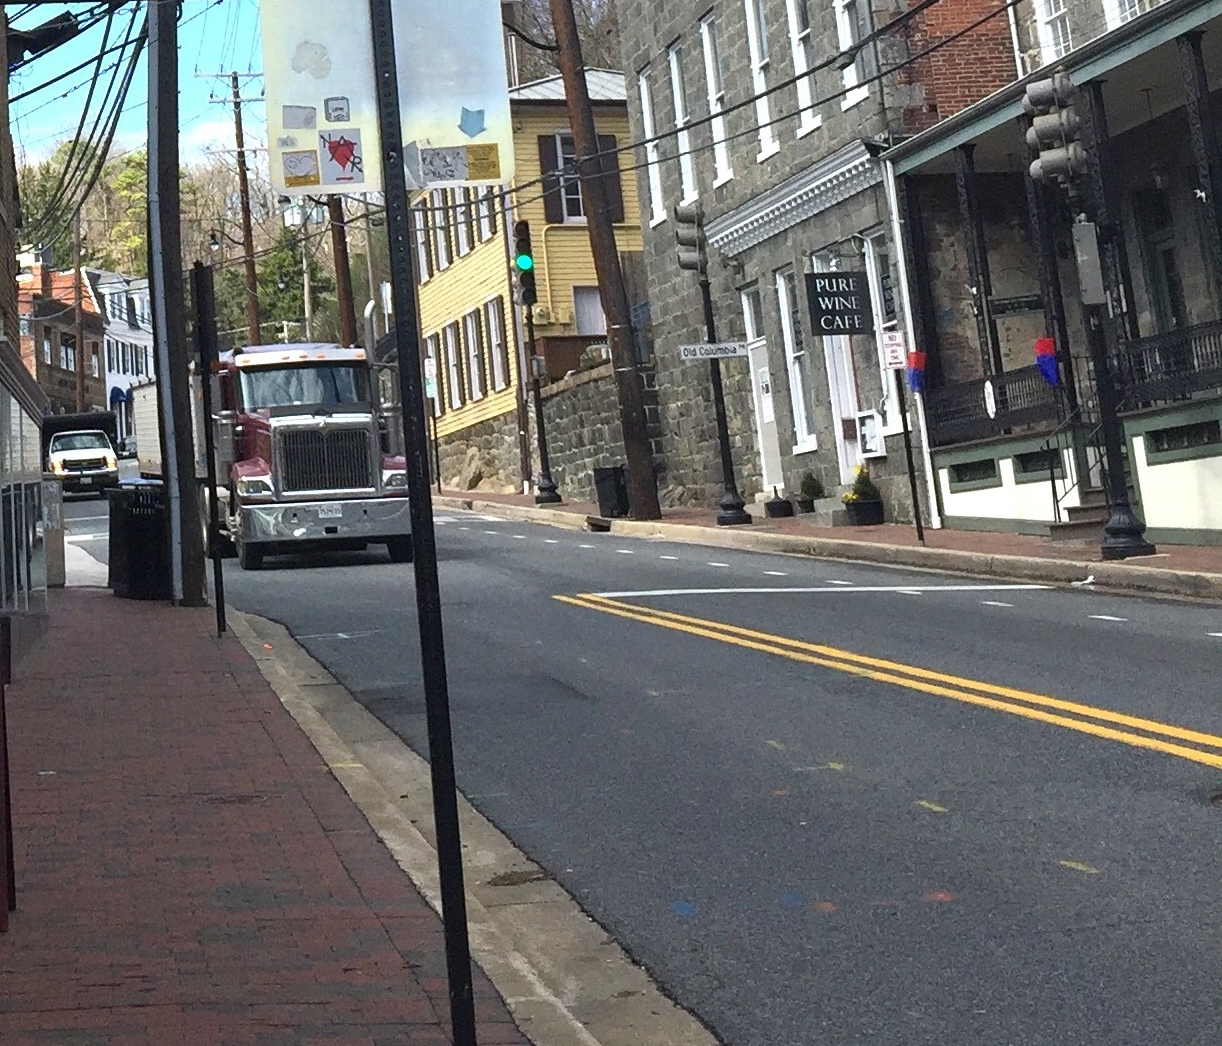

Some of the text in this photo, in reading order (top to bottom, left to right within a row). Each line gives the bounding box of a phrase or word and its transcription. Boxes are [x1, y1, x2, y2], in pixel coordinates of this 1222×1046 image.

[816, 277, 858, 292] PURE
[817, 295, 861, 311] WINE
[820, 314, 864, 330] CAFE
[683, 347, 697, 357] Old
[699, 345, 737, 356] Columbia
